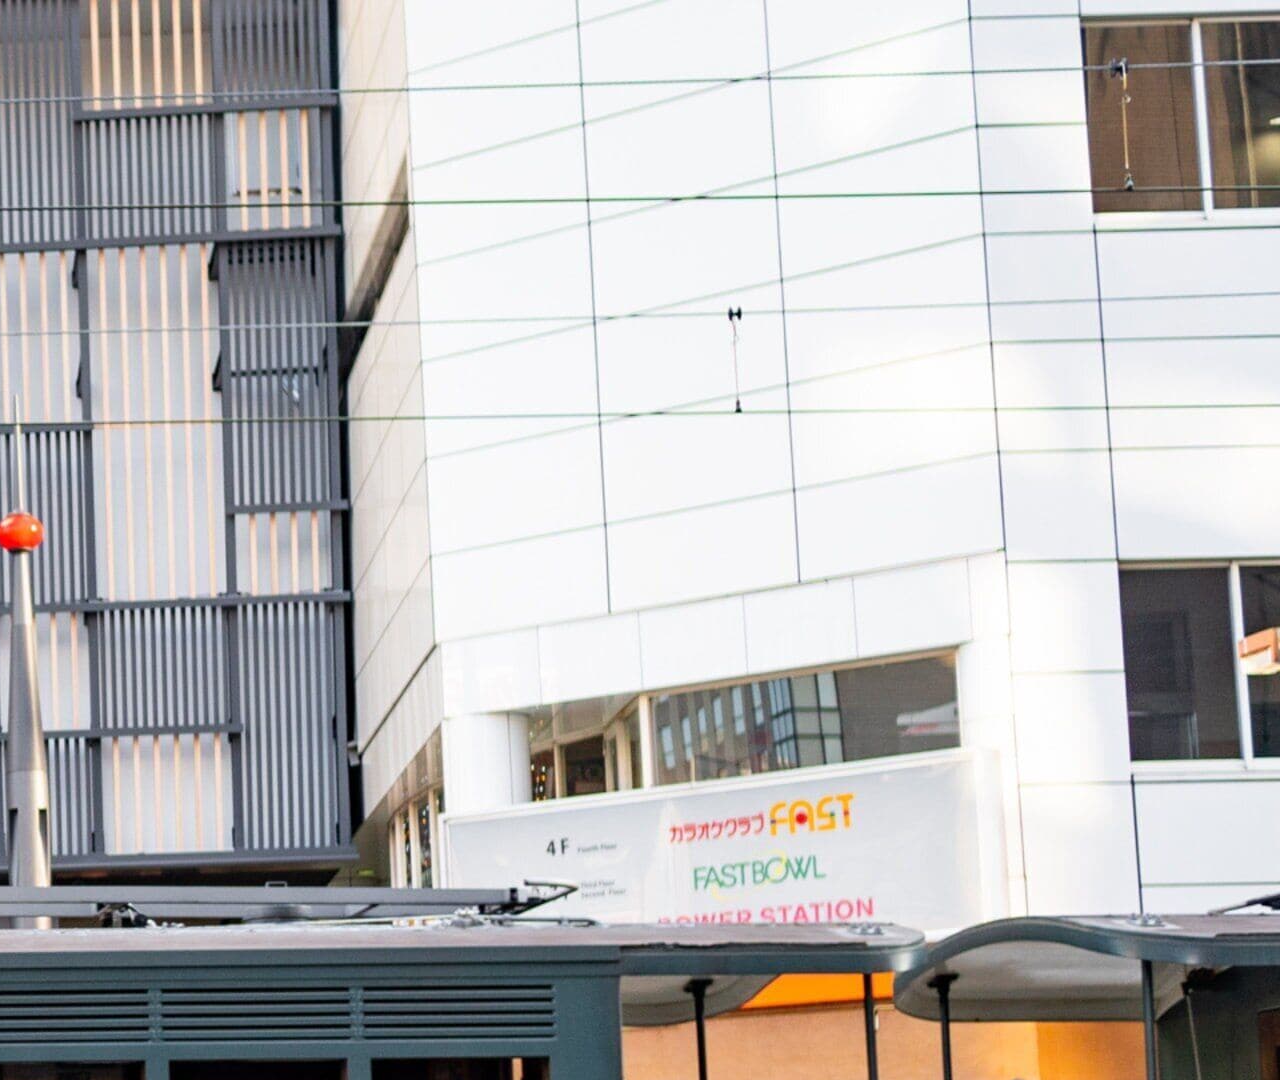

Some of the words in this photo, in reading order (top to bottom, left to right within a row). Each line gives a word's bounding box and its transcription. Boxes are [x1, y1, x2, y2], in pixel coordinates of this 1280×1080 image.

[669, 812, 765, 844] カラオケクラブ
[768, 793, 854, 836] FAST
[546, 839, 556, 856] 4
[561, 837, 569, 855] F
[760, 897, 874, 924] STATION
